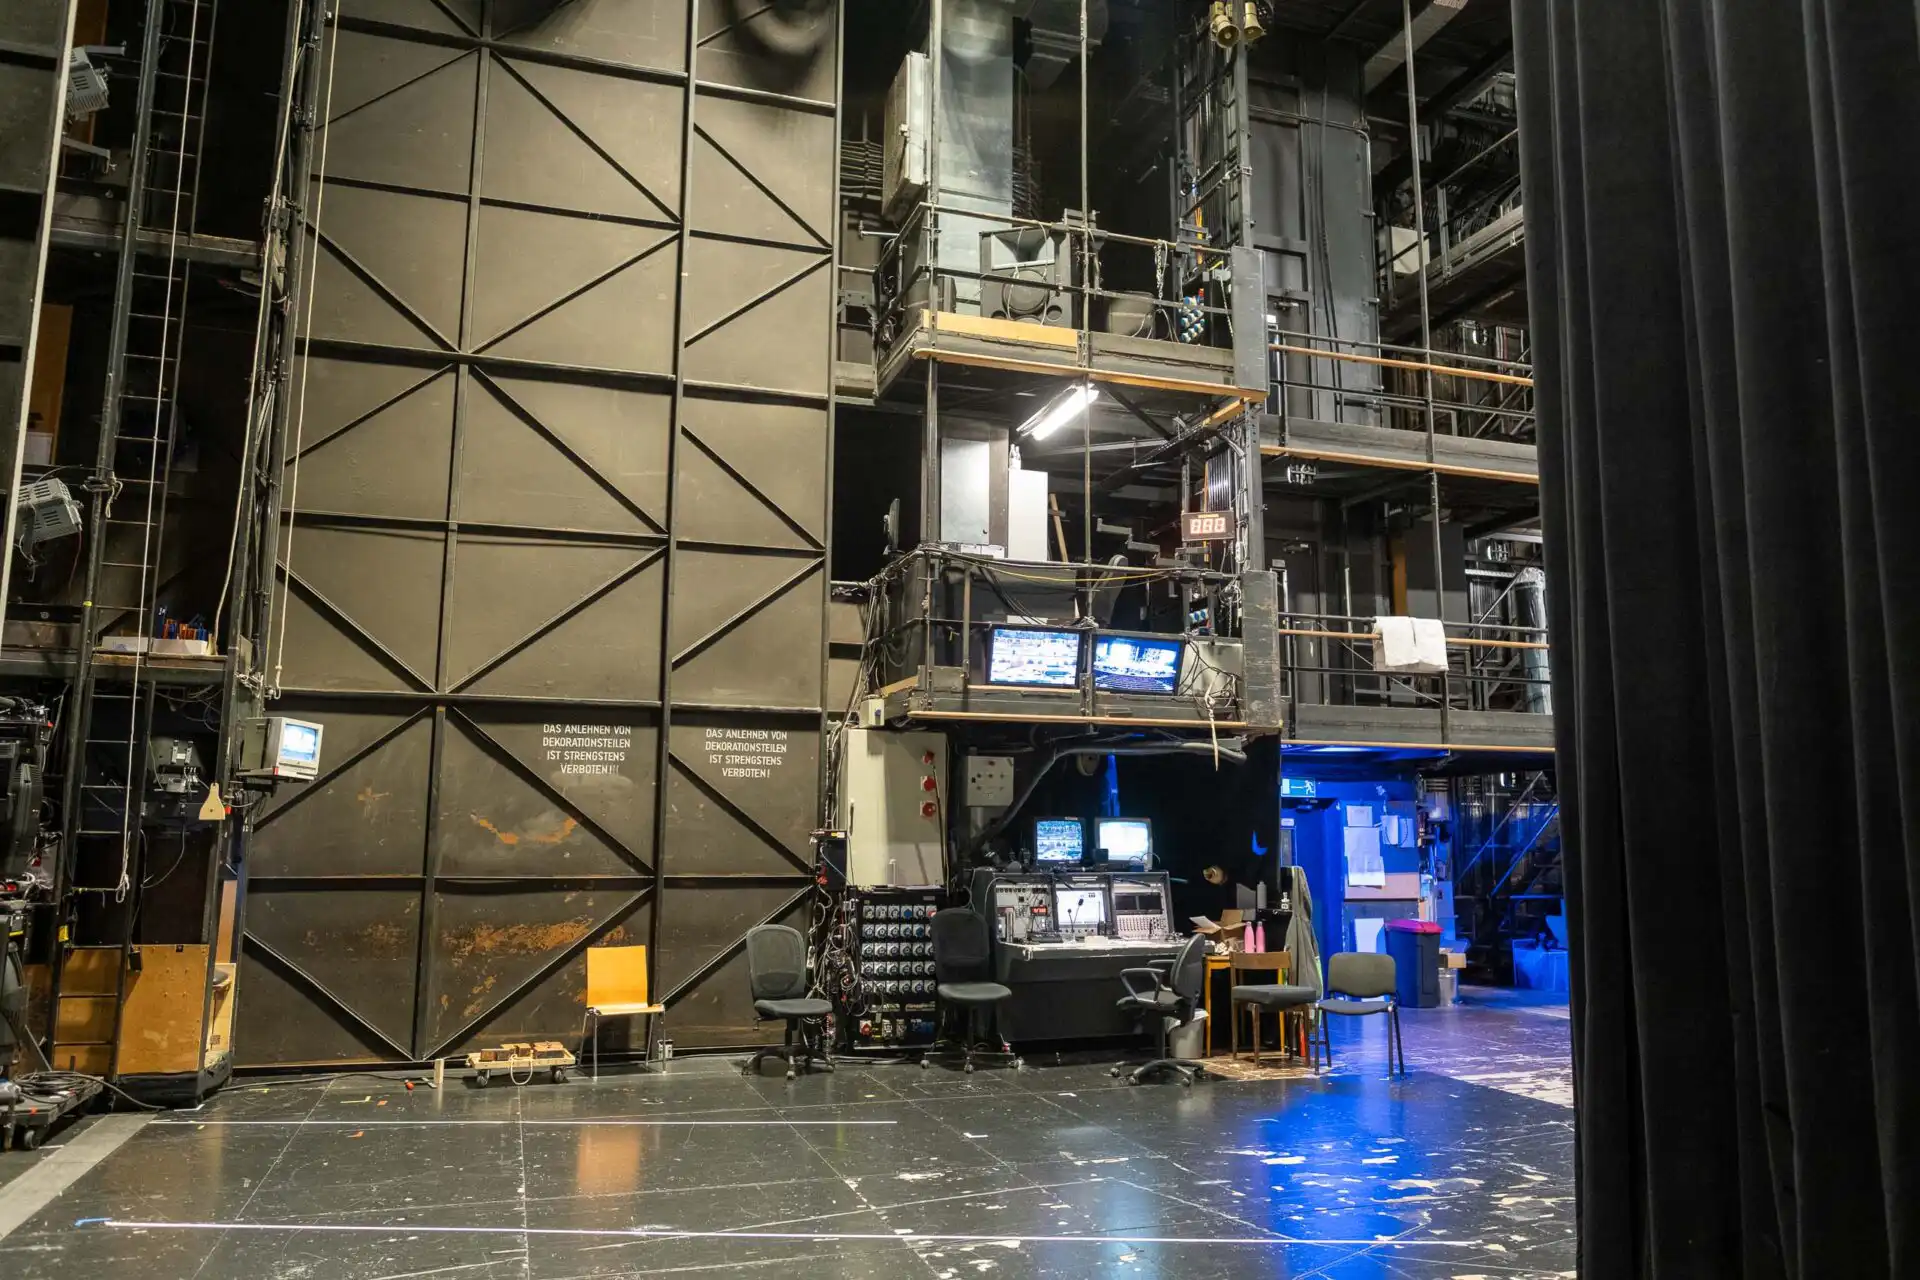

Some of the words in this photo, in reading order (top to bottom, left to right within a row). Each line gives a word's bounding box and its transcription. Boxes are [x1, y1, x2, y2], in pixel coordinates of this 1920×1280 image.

[543, 724, 561, 733] DAS
[564, 724, 611, 734] ANLEHNEN
[613, 725, 631, 735] VON
[705, 728, 722, 738] DAS
[725, 729, 768, 739] ANLEHNEN
[771, 730, 788, 740] VON
[542, 737, 631, 748] DEKORATIONSTEILEN
[705, 741, 787, 753] DEKORATIONSTEILEN
[547, 750, 561, 760] IST
[564, 751, 625, 761] STRENGSTENS
[709, 754, 723, 764] IST
[725, 755, 782, 765] STRENGSTENS
[722, 767, 771, 778] VERBOTEN!
